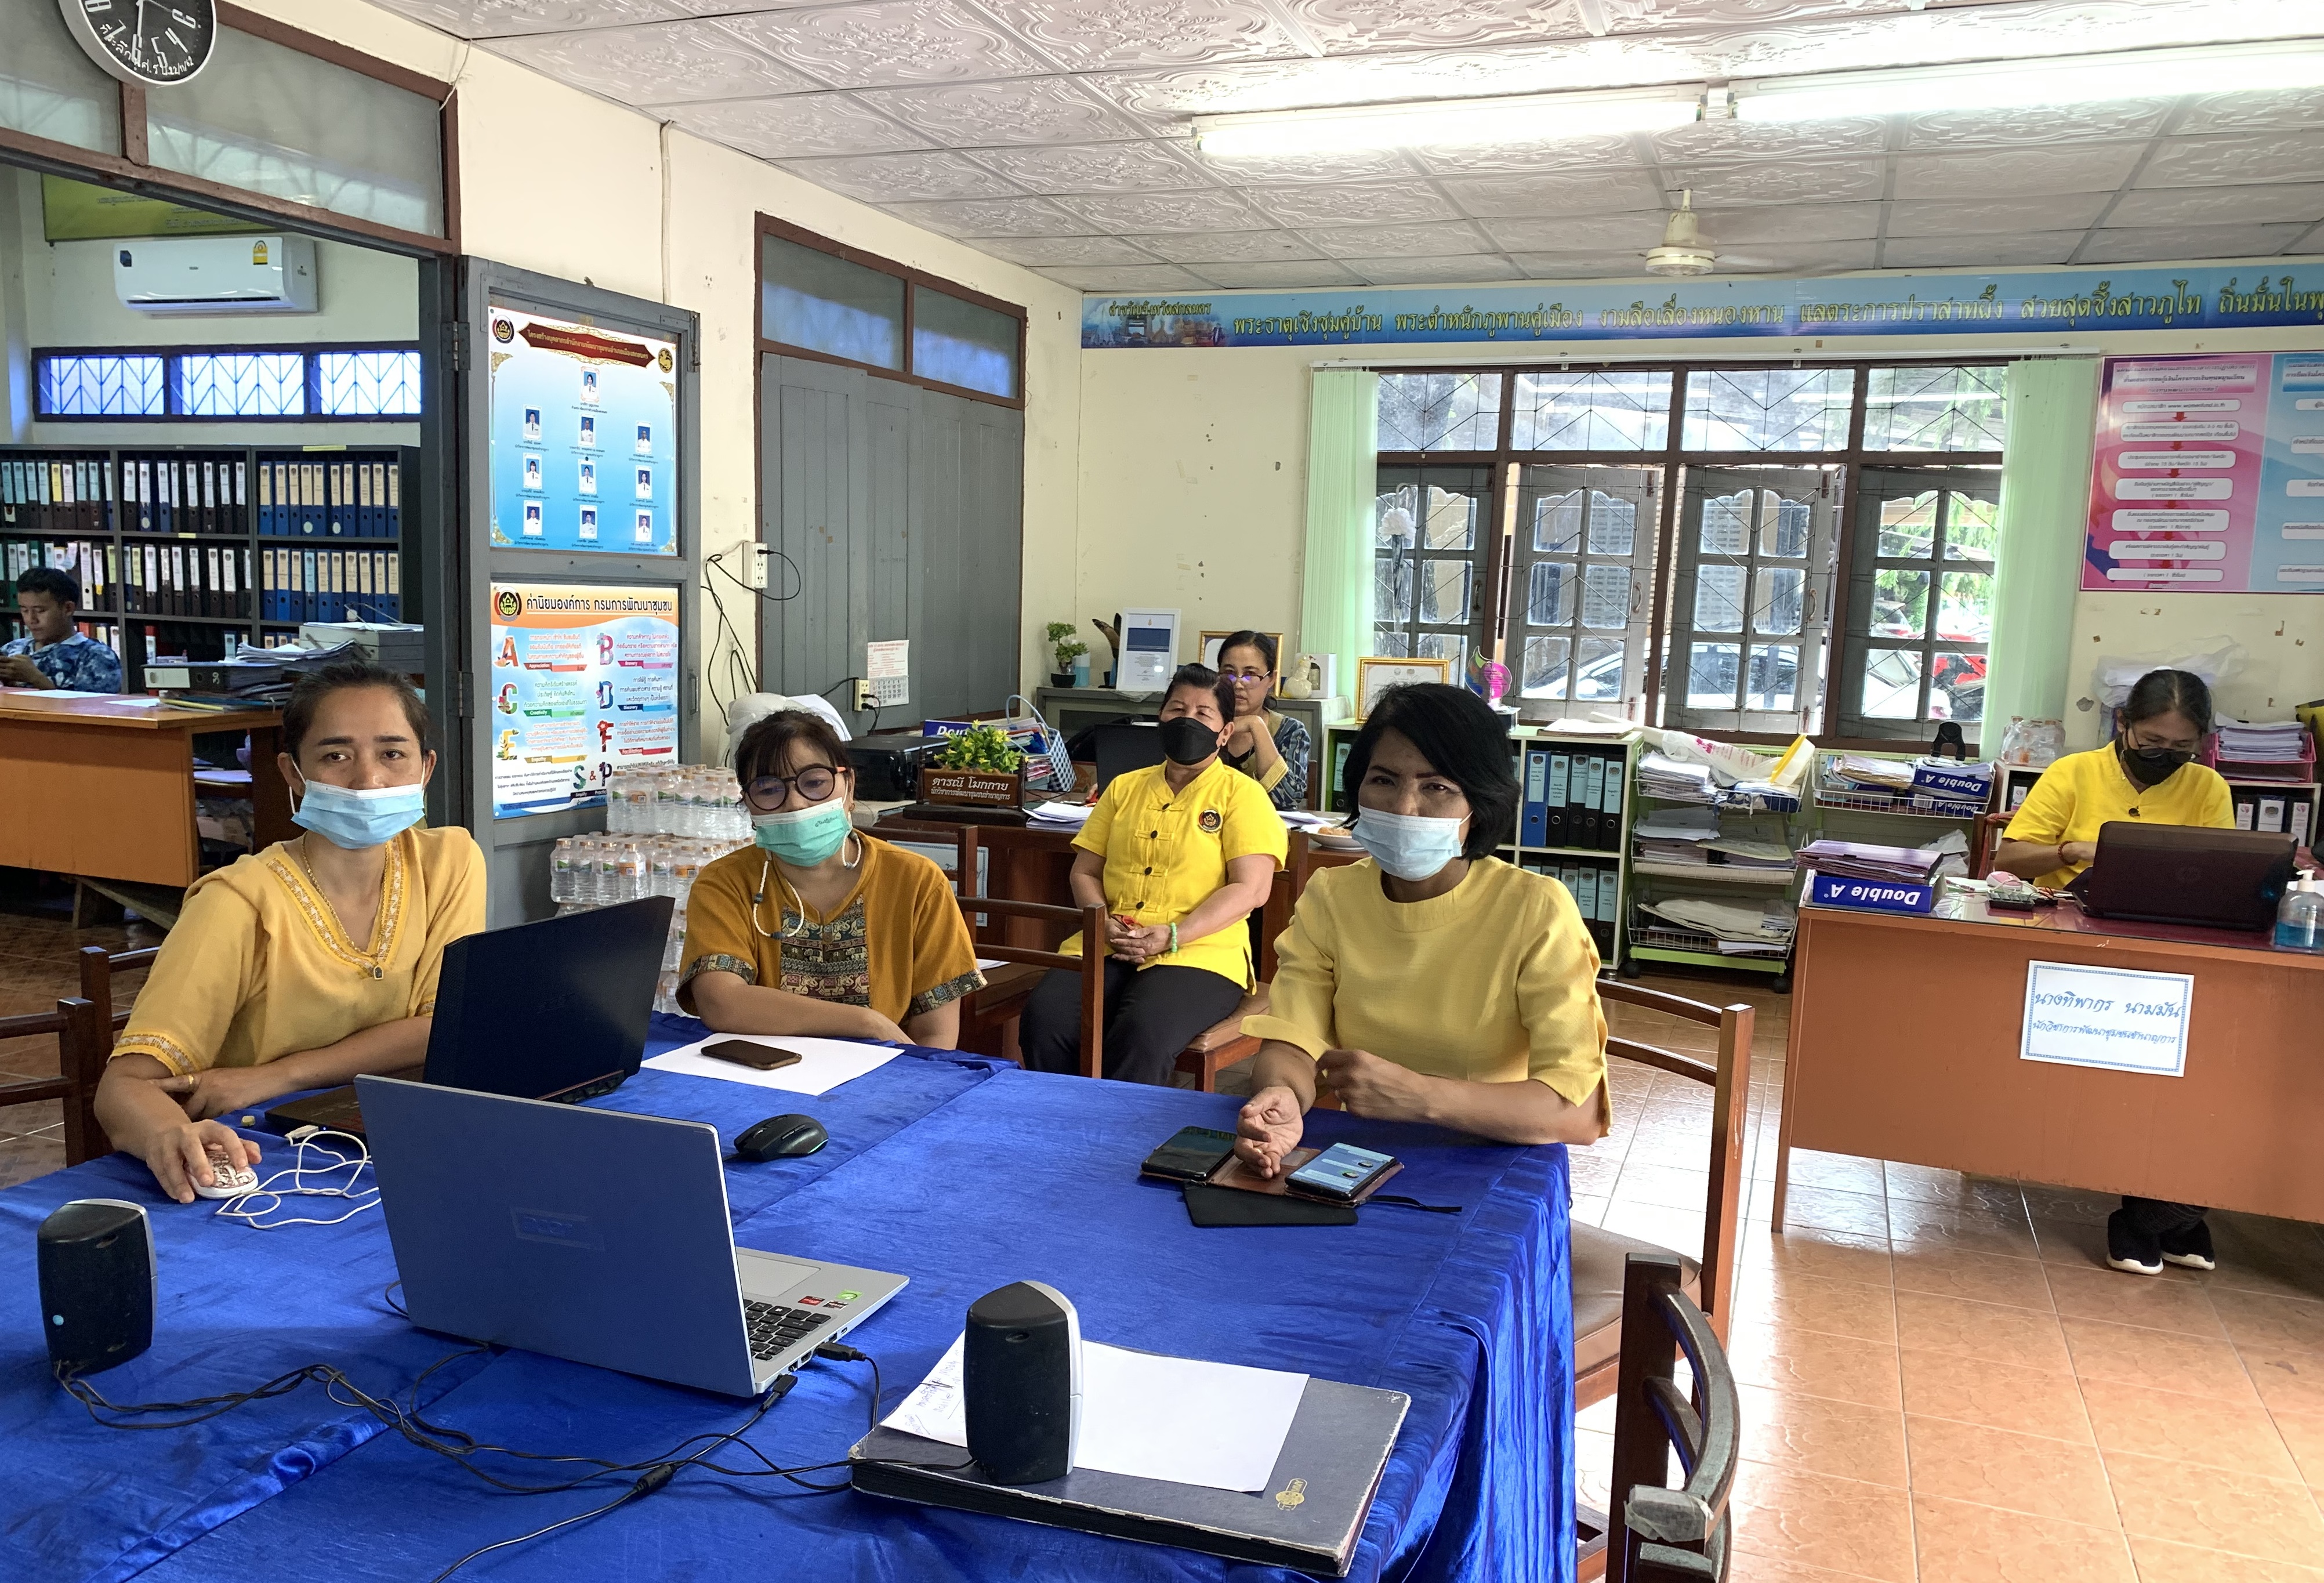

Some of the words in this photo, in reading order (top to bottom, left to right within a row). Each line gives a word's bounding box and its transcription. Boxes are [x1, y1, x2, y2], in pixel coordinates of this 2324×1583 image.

[1234, 305, 1382, 341] พระธาตุเชิงชุมคู่บ้าน
[1396, 302, 1583, 338] พระตำหนักภูพานคู่เมือง
[1600, 293, 1785, 328] งามลือเลื่องหนองหาน
[1800, 284, 2003, 323] แลตระการปราสาทผึ้ง
[2021, 280, 2202, 327] สวยสุดซึ้งสาวภูไท
[2218, 277, 2324, 321] ถิ่นมั่นในพุ
[527, 593, 590, 610] ค่านิยมองค์การ
[594, 596, 672, 615] กรมการพัฒนาชุมชน
[599, 635, 614, 665] B
[572, 765, 586, 790] S
[589, 770, 597, 781] &
[599, 761, 613, 787] P
[933, 777, 965, 788] ดารณี
[968, 776, 1009, 791] โมกกาย
[1926, 774, 1936, 783] A
[1938, 777, 1982, 792] Double
[1947, 802, 1979, 812] Double
[1831, 884, 1846, 898] A
[1851, 886, 1921, 906] Double
